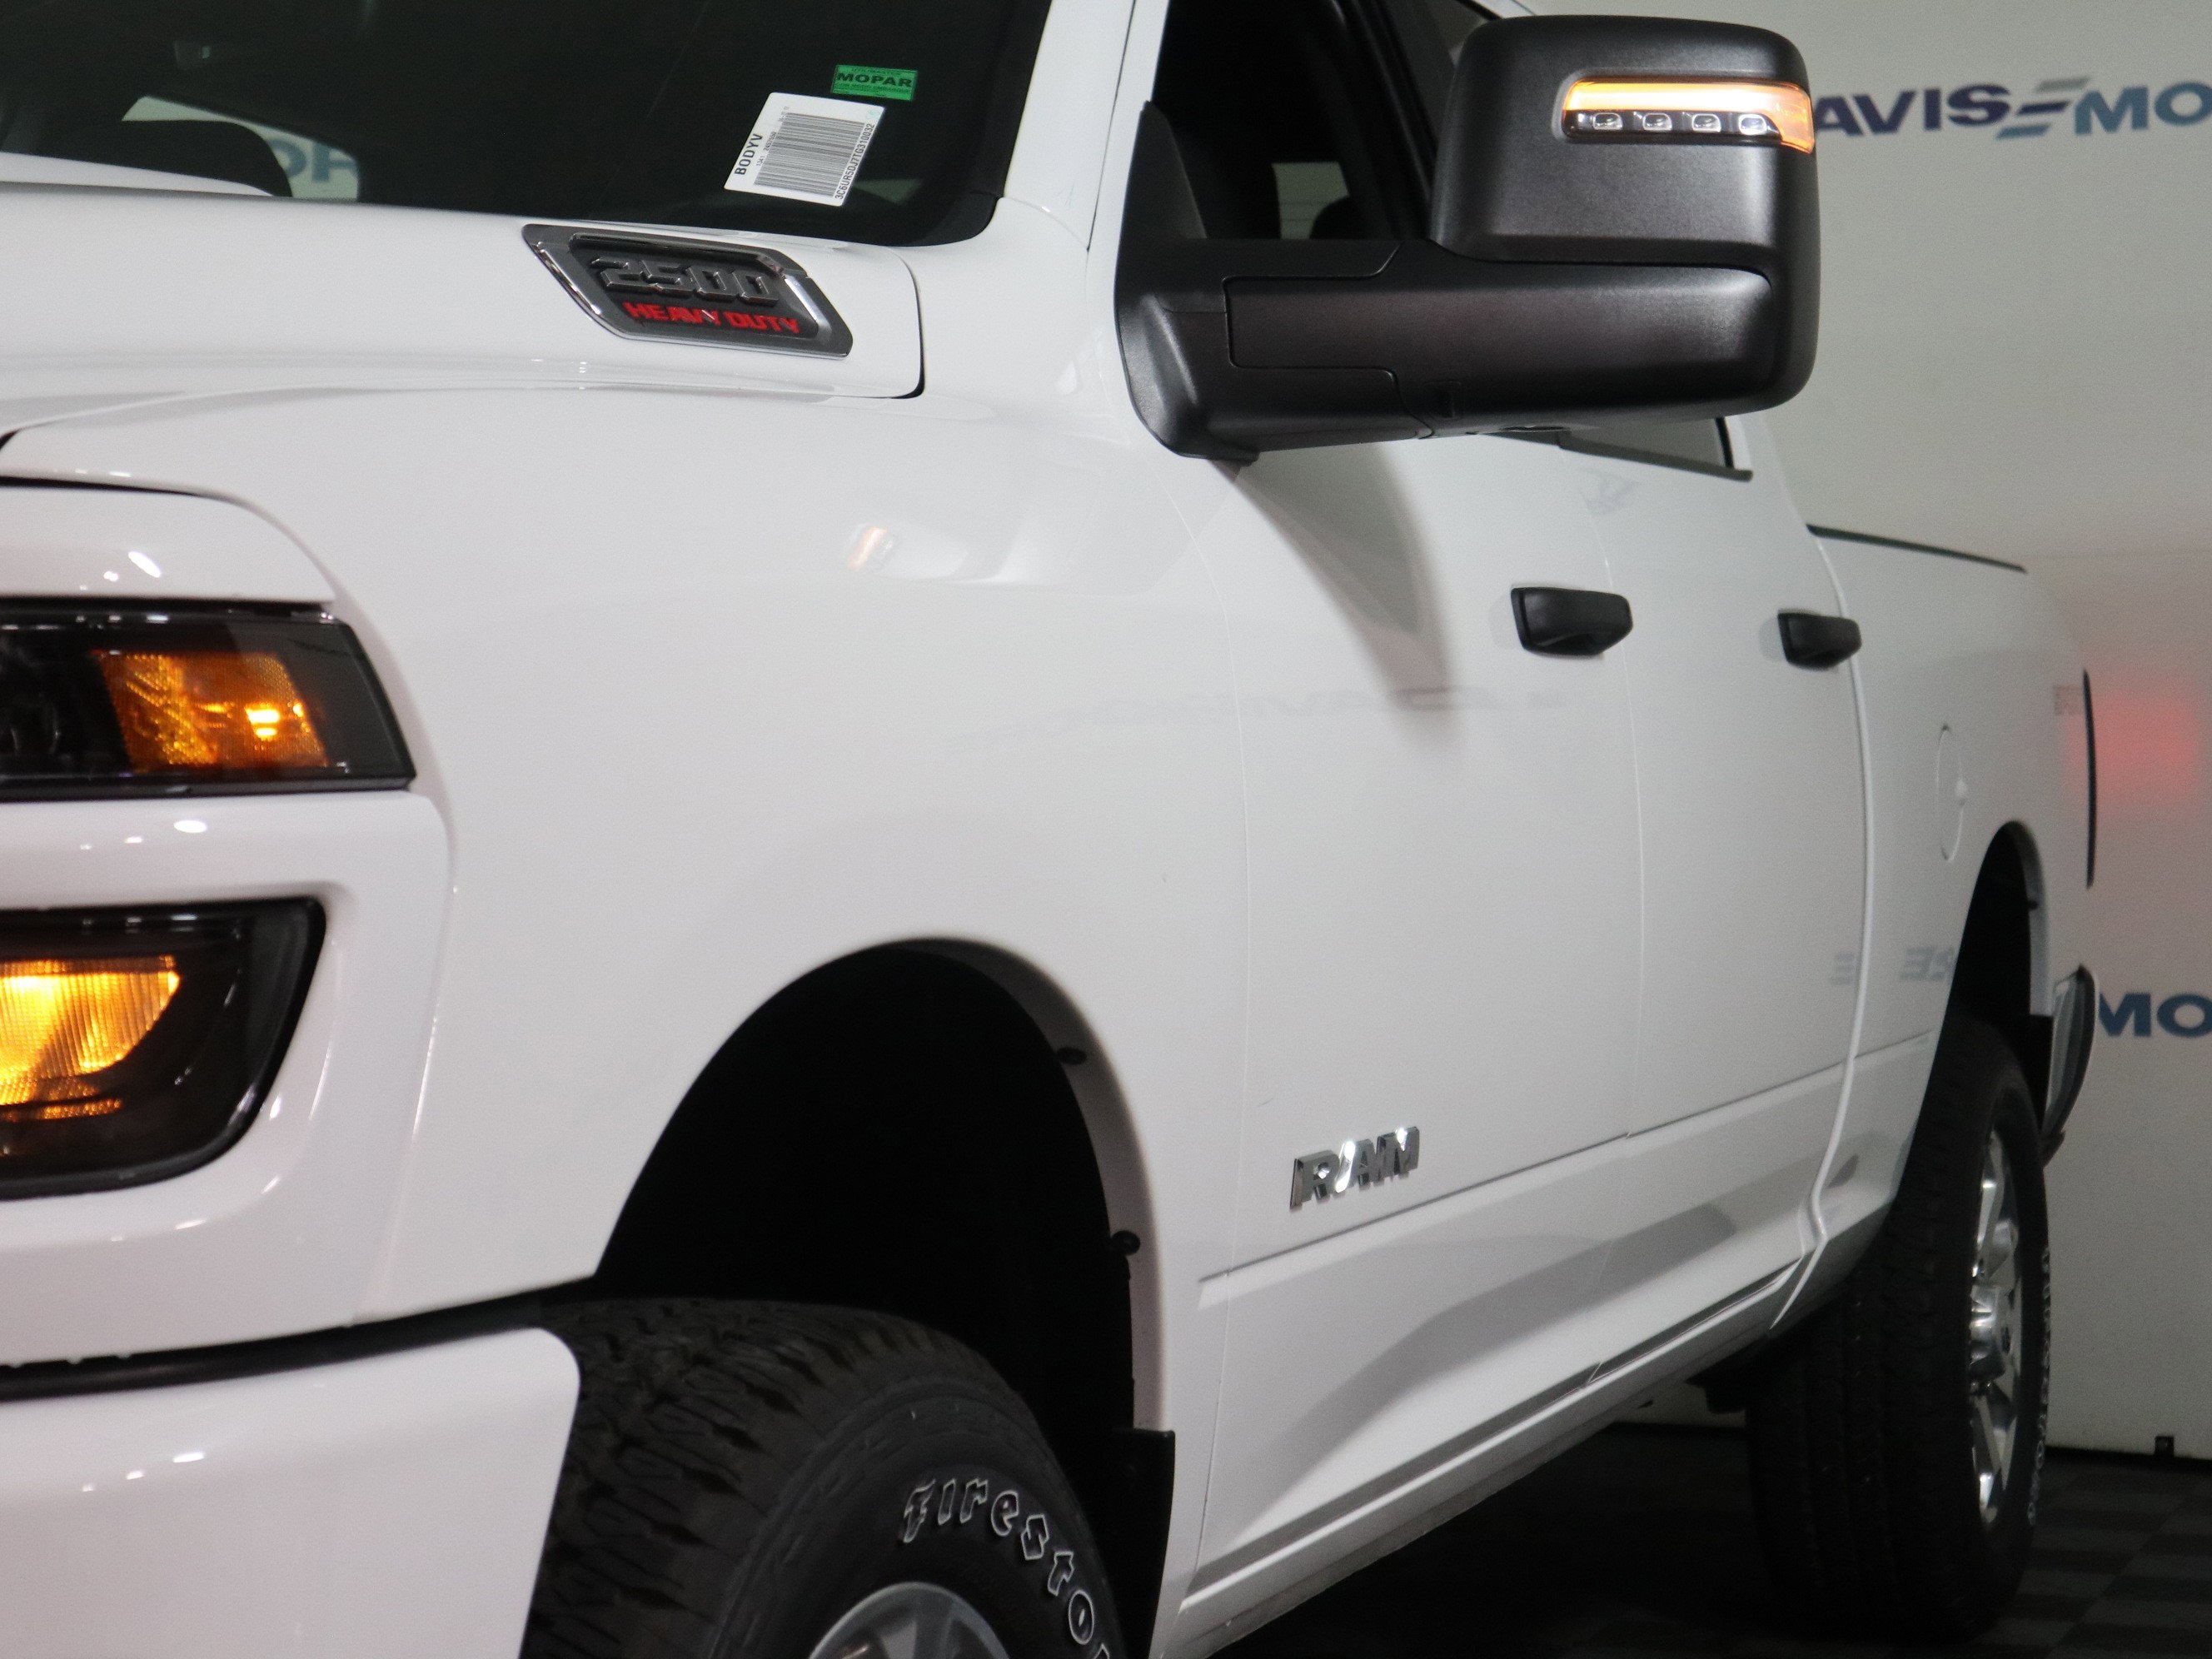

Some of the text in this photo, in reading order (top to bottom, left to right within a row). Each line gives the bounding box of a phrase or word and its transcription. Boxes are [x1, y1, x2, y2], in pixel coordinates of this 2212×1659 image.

[836, 72, 913, 87] MOPAR
[734, 132, 764, 176] BODYV
[590, 257, 780, 305] 2500
[622, 301, 800, 334] HEAVY DUTY
[1289, 1126, 1420, 1211] RAM
[903, 1477, 1110, 1659] Firesto
